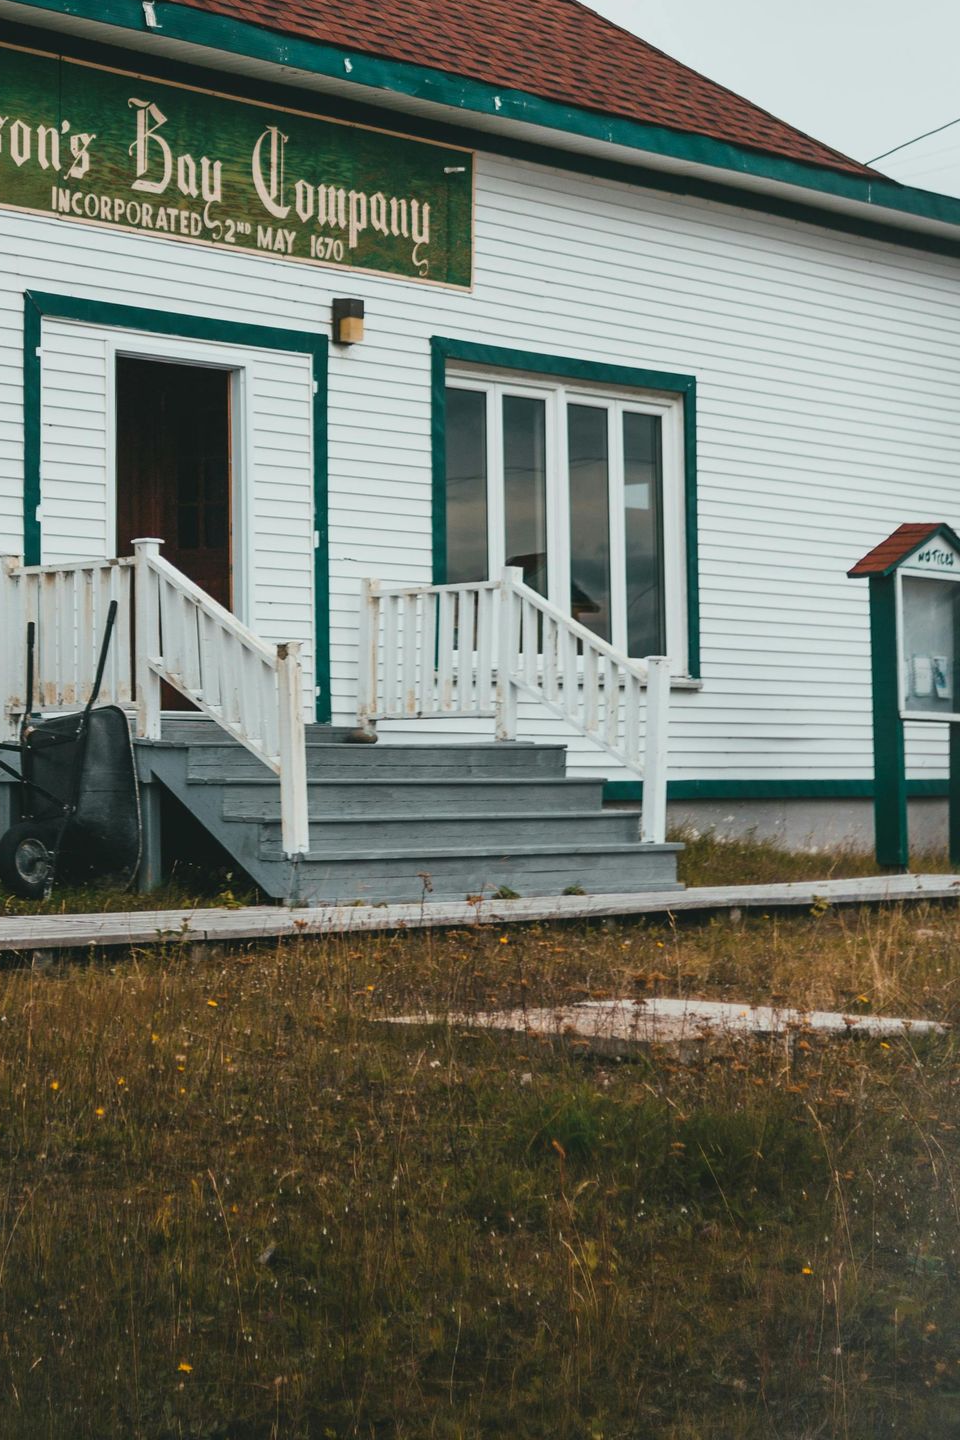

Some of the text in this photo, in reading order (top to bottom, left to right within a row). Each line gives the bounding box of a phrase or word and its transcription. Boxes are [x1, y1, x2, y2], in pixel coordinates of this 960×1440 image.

[51, 186, 344, 261] INCORPORATED 2ND MAY 1670
[127, 97, 223, 240] Bay
[252, 125, 431, 277] Company
